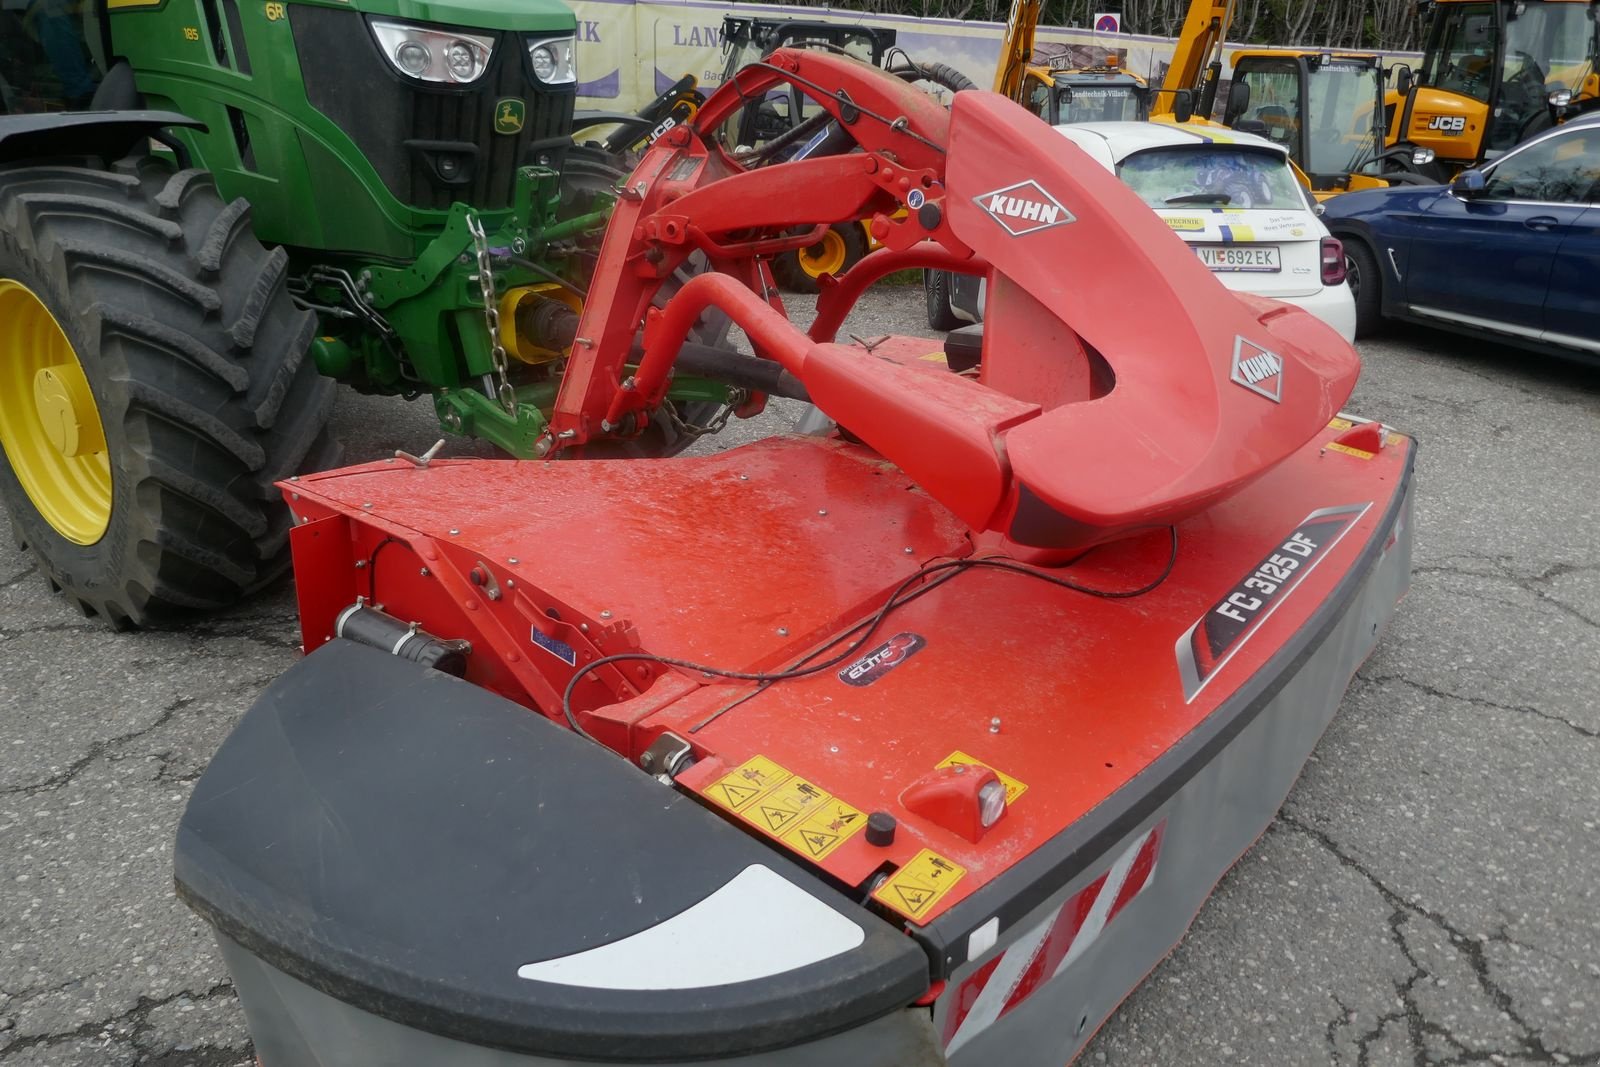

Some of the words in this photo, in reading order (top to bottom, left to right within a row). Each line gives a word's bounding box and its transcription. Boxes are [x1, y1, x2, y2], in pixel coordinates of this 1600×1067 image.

[265, 2, 285, 21] 6R
[183, 27, 199, 41] 185
[576, 20, 601, 43] IK
[673, 24, 726, 48] LAN
[648, 116, 677, 145] JCB
[1428, 116, 1466, 132] JCB
[988, 194, 1060, 225] KUHN
[1202, 250, 1216, 265] VI
[1227, 250, 1253, 265] 692
[1256, 251, 1273, 265] EK
[1238, 352, 1281, 385] KUHN
[1215, 591, 1263, 623] FC
[1243, 553, 1300, 595] 3125
[1281, 532, 1318, 558] DF
